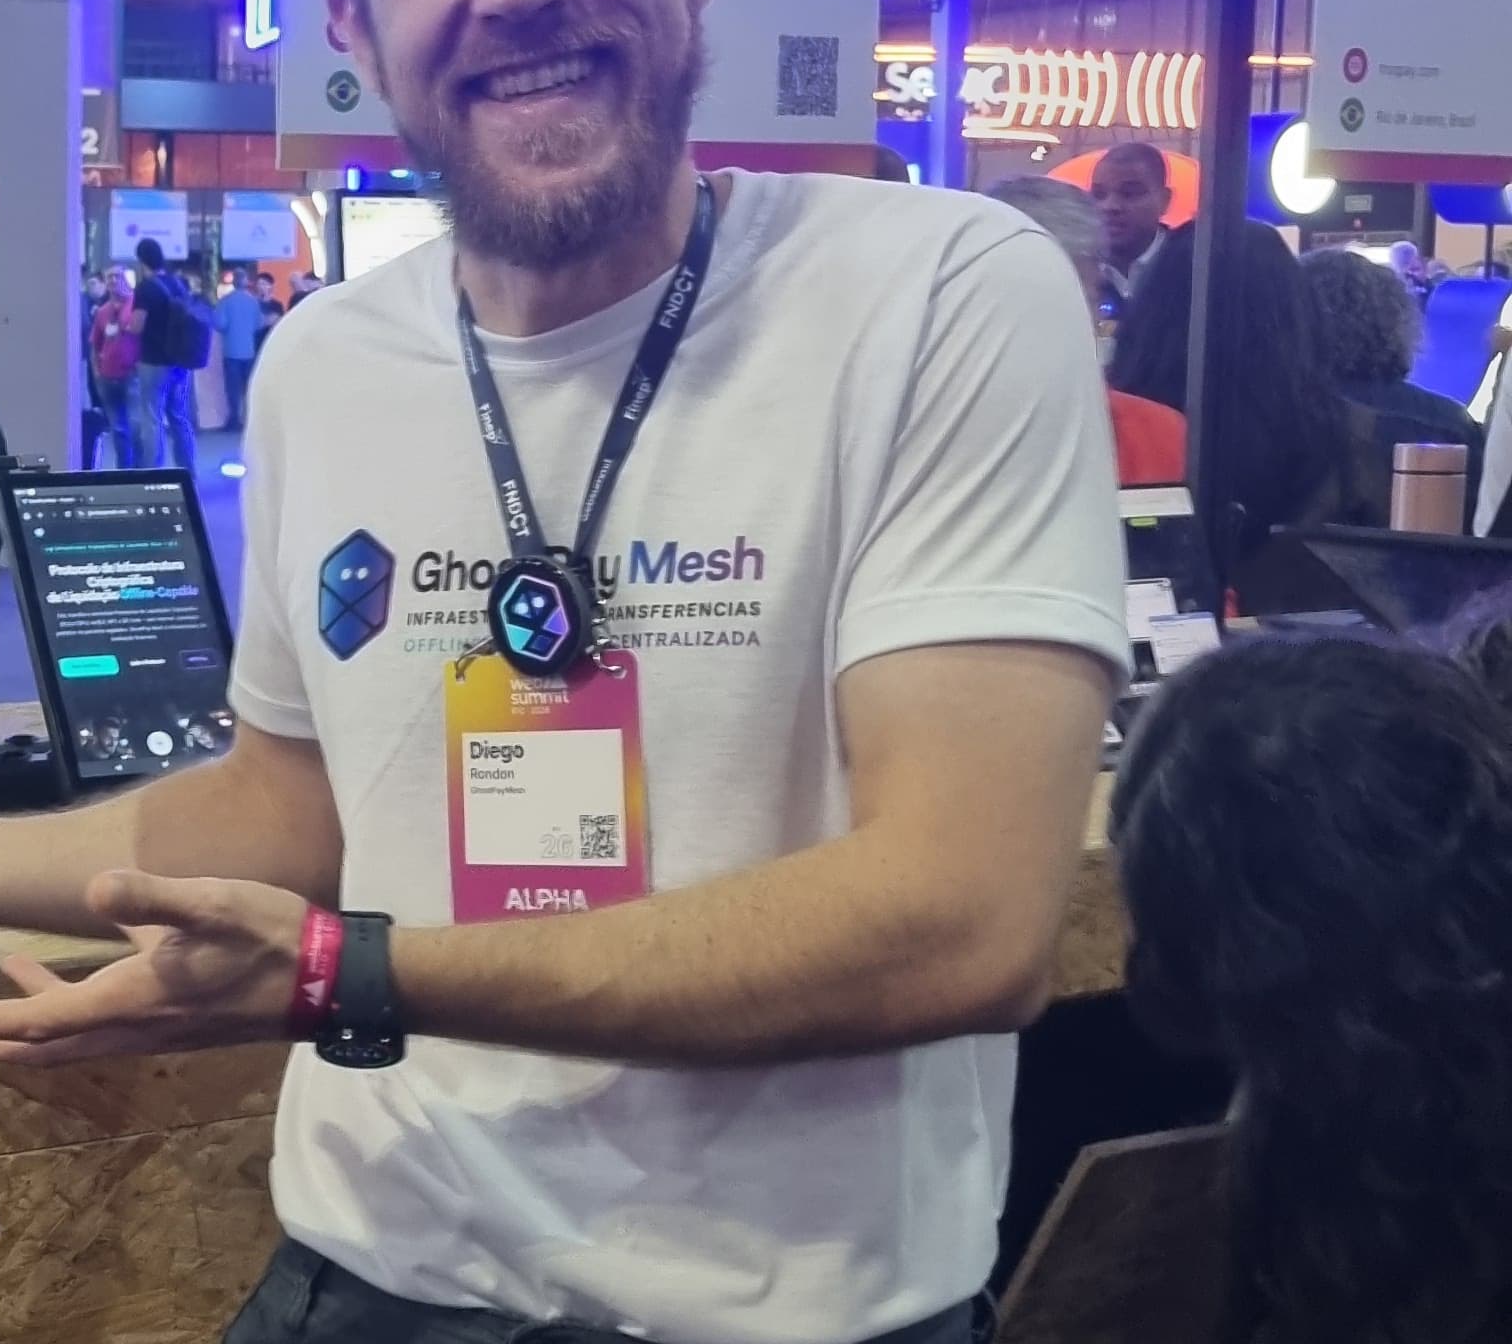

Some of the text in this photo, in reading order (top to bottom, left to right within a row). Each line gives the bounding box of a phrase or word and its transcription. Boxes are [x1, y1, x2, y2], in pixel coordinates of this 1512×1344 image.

[501, 478, 530, 539] FNDCT
[628, 534, 765, 585] Mesh
[607, 601, 762, 621] RANSFERENCIAS
[469, 740, 525, 764] Diego
[503, 887, 588, 913] ALPHA
